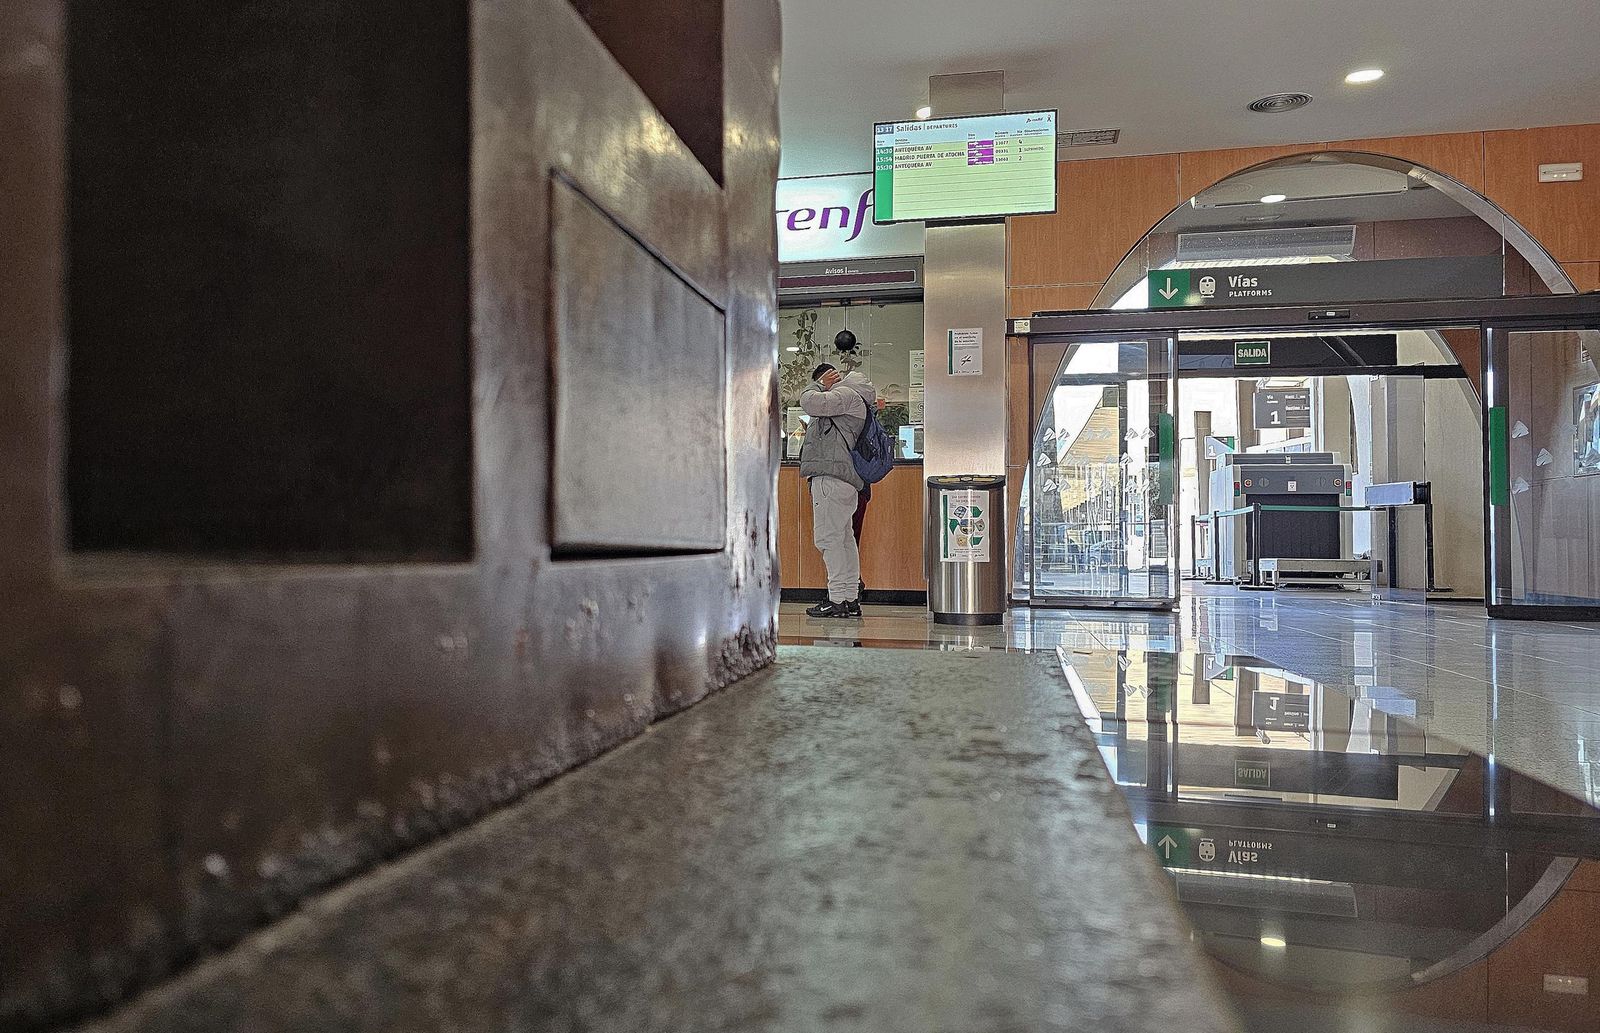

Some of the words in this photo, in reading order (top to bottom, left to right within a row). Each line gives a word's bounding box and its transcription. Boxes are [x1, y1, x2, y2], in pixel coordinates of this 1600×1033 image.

[896, 124, 922, 132] Salidas
[1228, 275, 1258, 288] Vías
[1238, 348, 1267, 358] SALIDA
[1270, 411, 1281, 424] 1
[1208, 445, 1216, 456] 1
